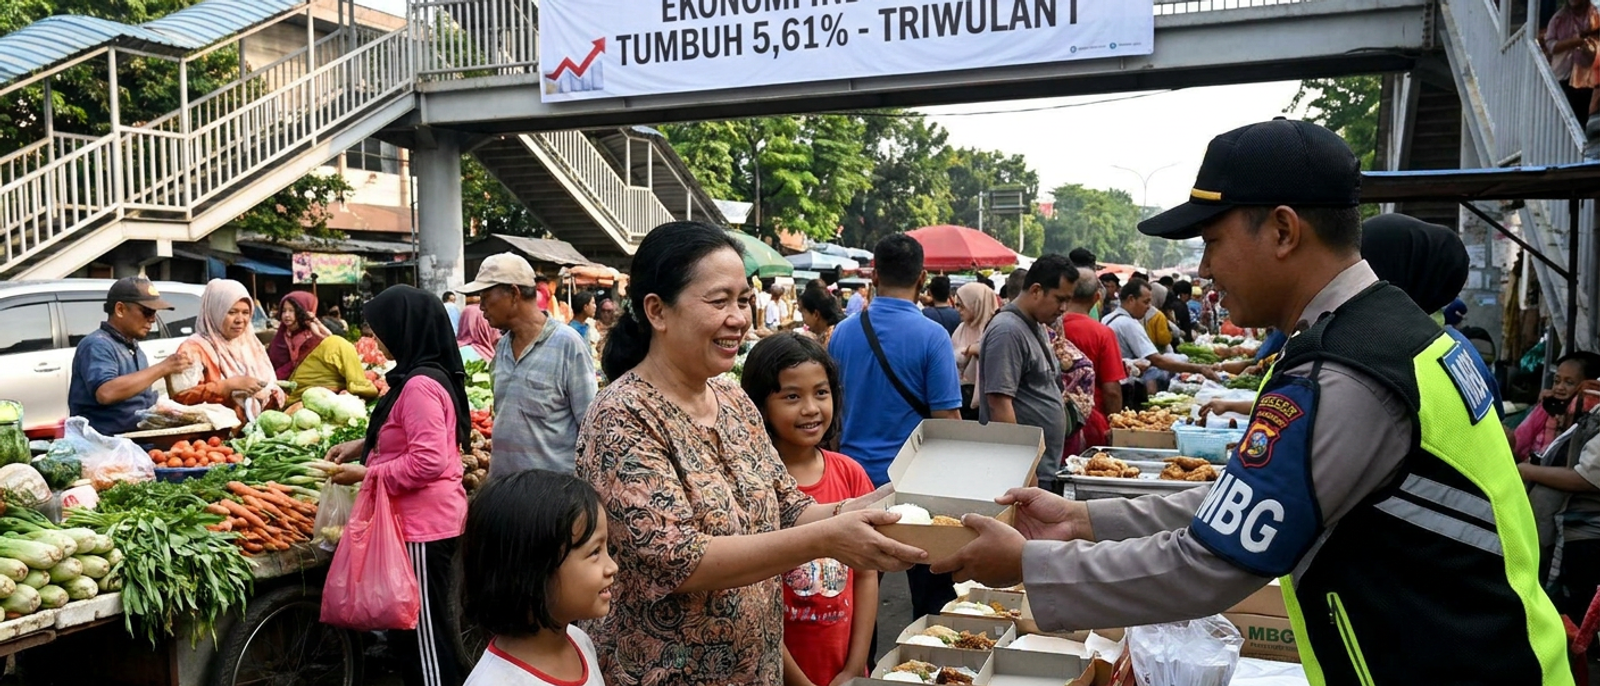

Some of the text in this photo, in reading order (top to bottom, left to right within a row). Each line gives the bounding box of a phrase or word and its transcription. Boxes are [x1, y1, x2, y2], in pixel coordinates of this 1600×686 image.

[616, 24, 742, 66] TUMBUH
[752, 12, 849, 59] 5,61%
[878, 0, 1056, 42] TRIWULAN
[1195, 469, 1285, 553] MBG
[1248, 626, 1295, 644] MBG
